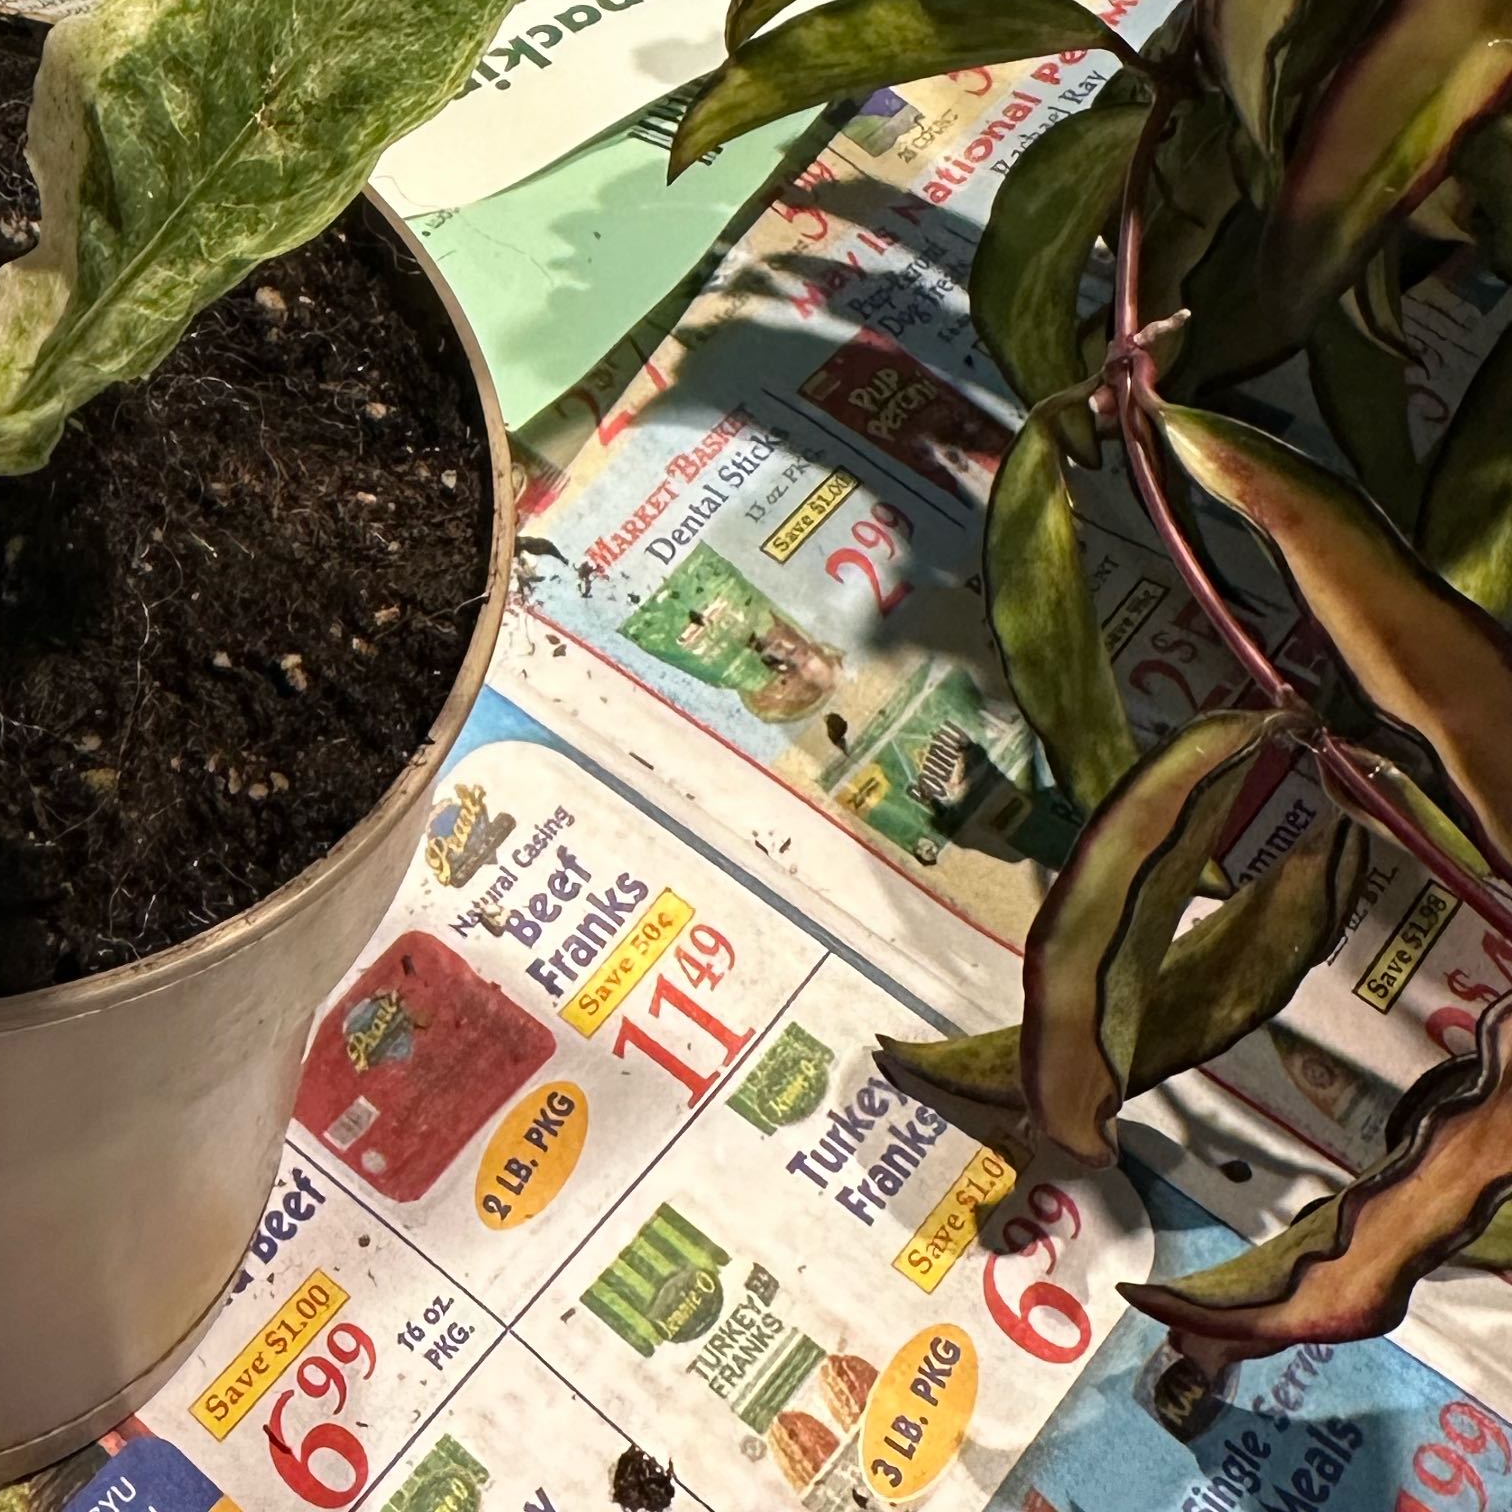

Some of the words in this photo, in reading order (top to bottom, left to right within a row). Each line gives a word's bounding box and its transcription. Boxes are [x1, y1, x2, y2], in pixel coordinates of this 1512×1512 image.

[1058, 69, 1110, 107] Ray
[585, 476, 681, 578] MARKET
[666, 403, 756, 485] BASKET
[643, 483, 730, 566] Dental
[772, 515, 815, 555] Save
[824, 501, 915, 618] 299
[511, 804, 576, 869] Casing
[503, 844, 592, 949] Beef
[524, 871, 650, 999] Franks
[579, 955, 634, 1017] Save
[630, 911, 675, 957] 50¢
[1366, 945, 1413, 1001] Save
[1402, 893, 1449, 952] $1.98
[611, 922, 757, 1110] 1149
[522, 1090, 577, 1152] PKG
[785, 1074, 908, 1190] Turkey
[481, 1194, 513, 1221] 2
[495, 1152, 541, 1197] LB.
[834, 1105, 949, 1227] Franks
[906, 1213, 966, 1276] Save
[955, 1155, 1008, 1215] $1.0
[982, 1182, 1092, 1365] 699
[204, 1354, 271, 1421] Save
[265, 1283, 331, 1356] $1.00
[396, 1319, 427, 1352] 16
[423, 1323, 477, 1371] PKG.
[685, 1293, 763, 1382] TURKEY
[708, 1311, 785, 1400] FRANKS
[909, 1336, 962, 1407] PKG
[266, 1322, 377, 1510] 699
[883, 1413, 930, 1462] LB.
[870, 1457, 904, 1488] 3
